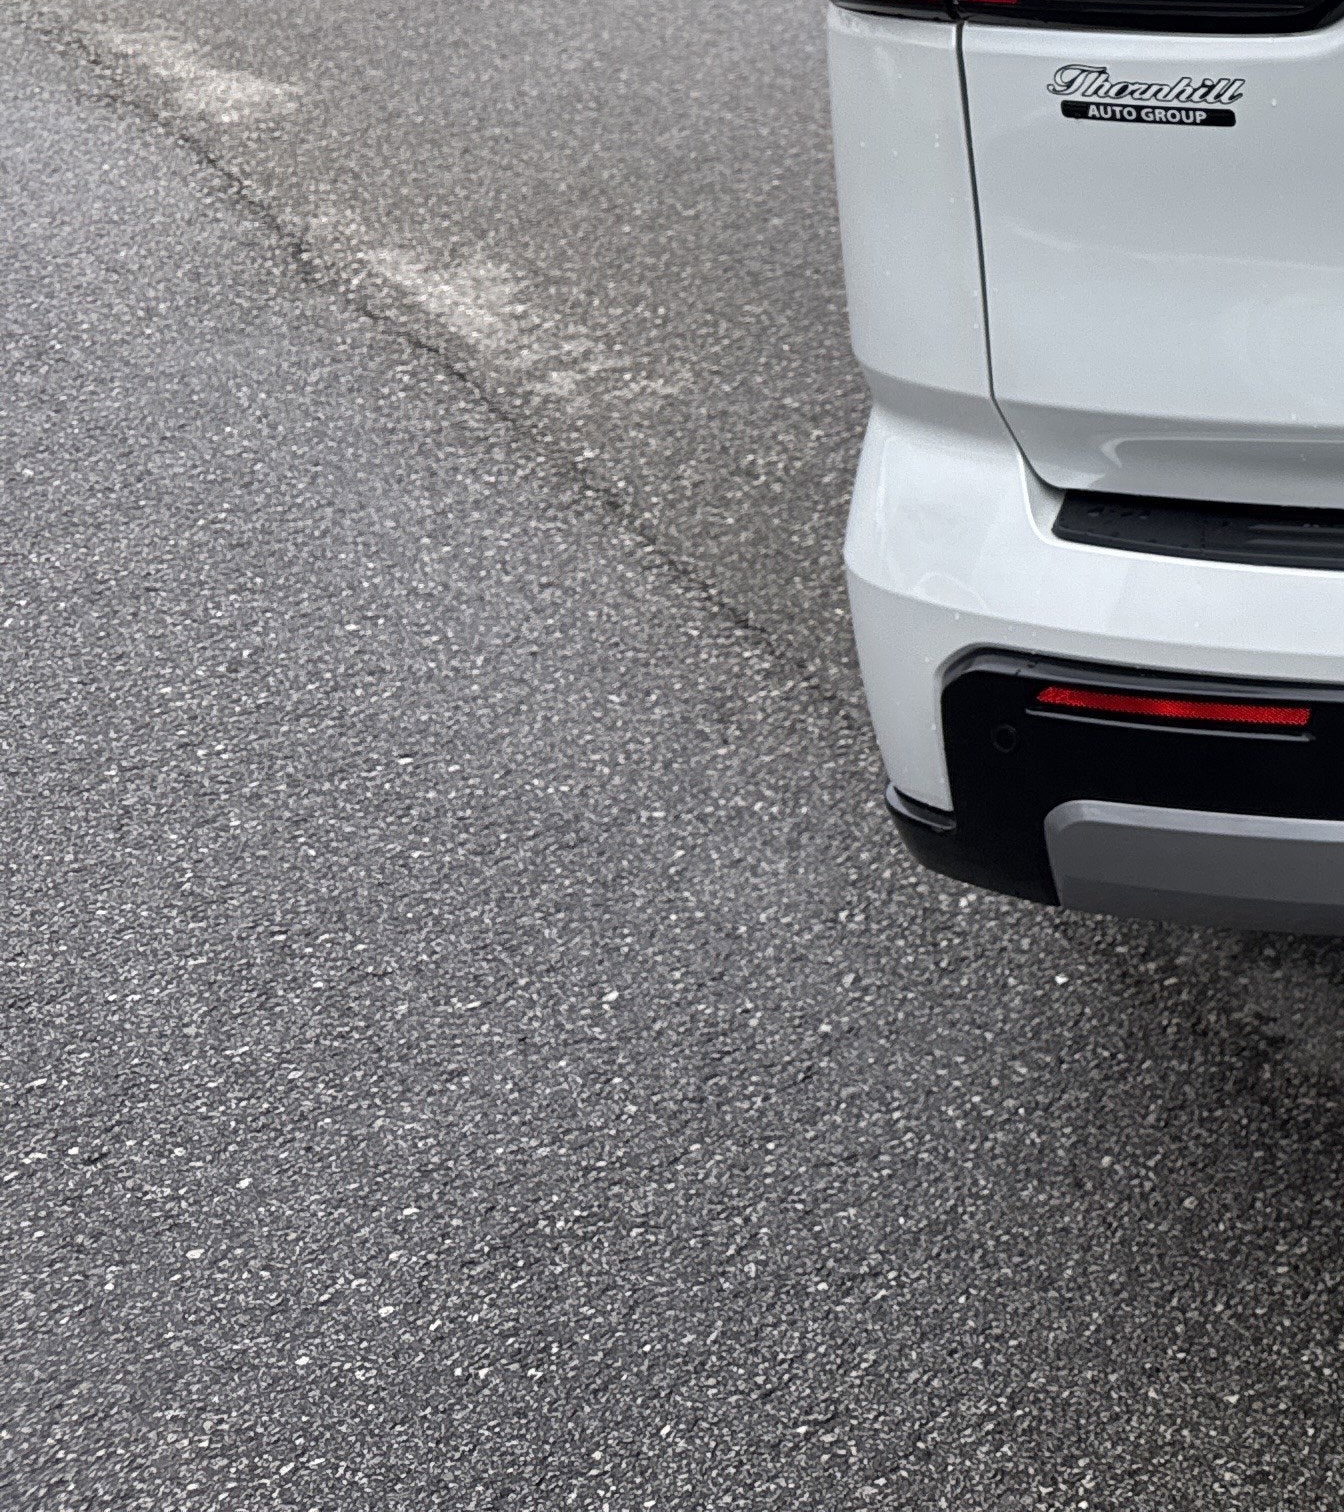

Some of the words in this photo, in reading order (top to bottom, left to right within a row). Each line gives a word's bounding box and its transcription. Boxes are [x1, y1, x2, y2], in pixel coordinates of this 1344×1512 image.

[1047, 64, 1246, 104] Thornhill
[1088, 104, 1137, 121] AUTO
[1141, 107, 1207, 123] GROUP
